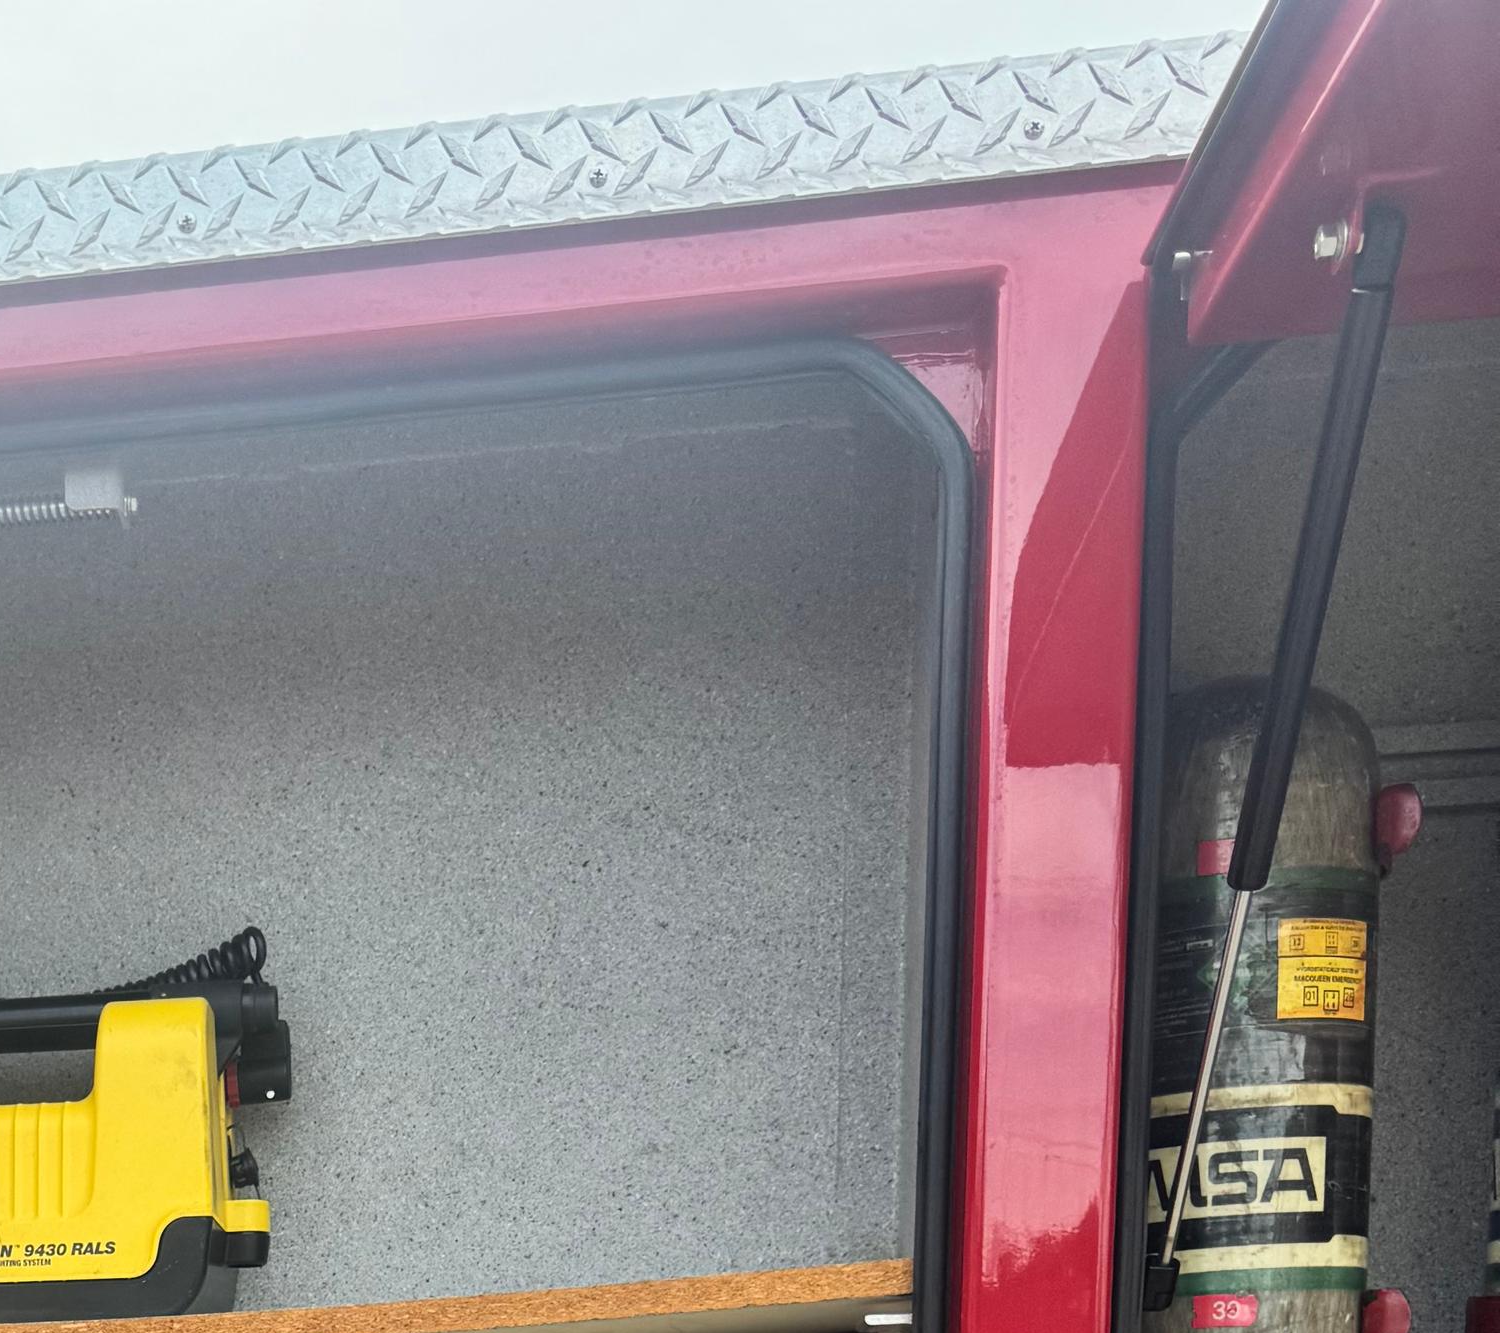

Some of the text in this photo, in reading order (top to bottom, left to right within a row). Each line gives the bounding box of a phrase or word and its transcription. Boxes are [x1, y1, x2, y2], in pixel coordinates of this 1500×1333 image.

[1149, 1148, 1318, 1209] MSA
[24, 1243, 67, 1257] 9430
[71, 1241, 116, 1256] RALS
[23, 1258, 51, 1267] SYSTEM
